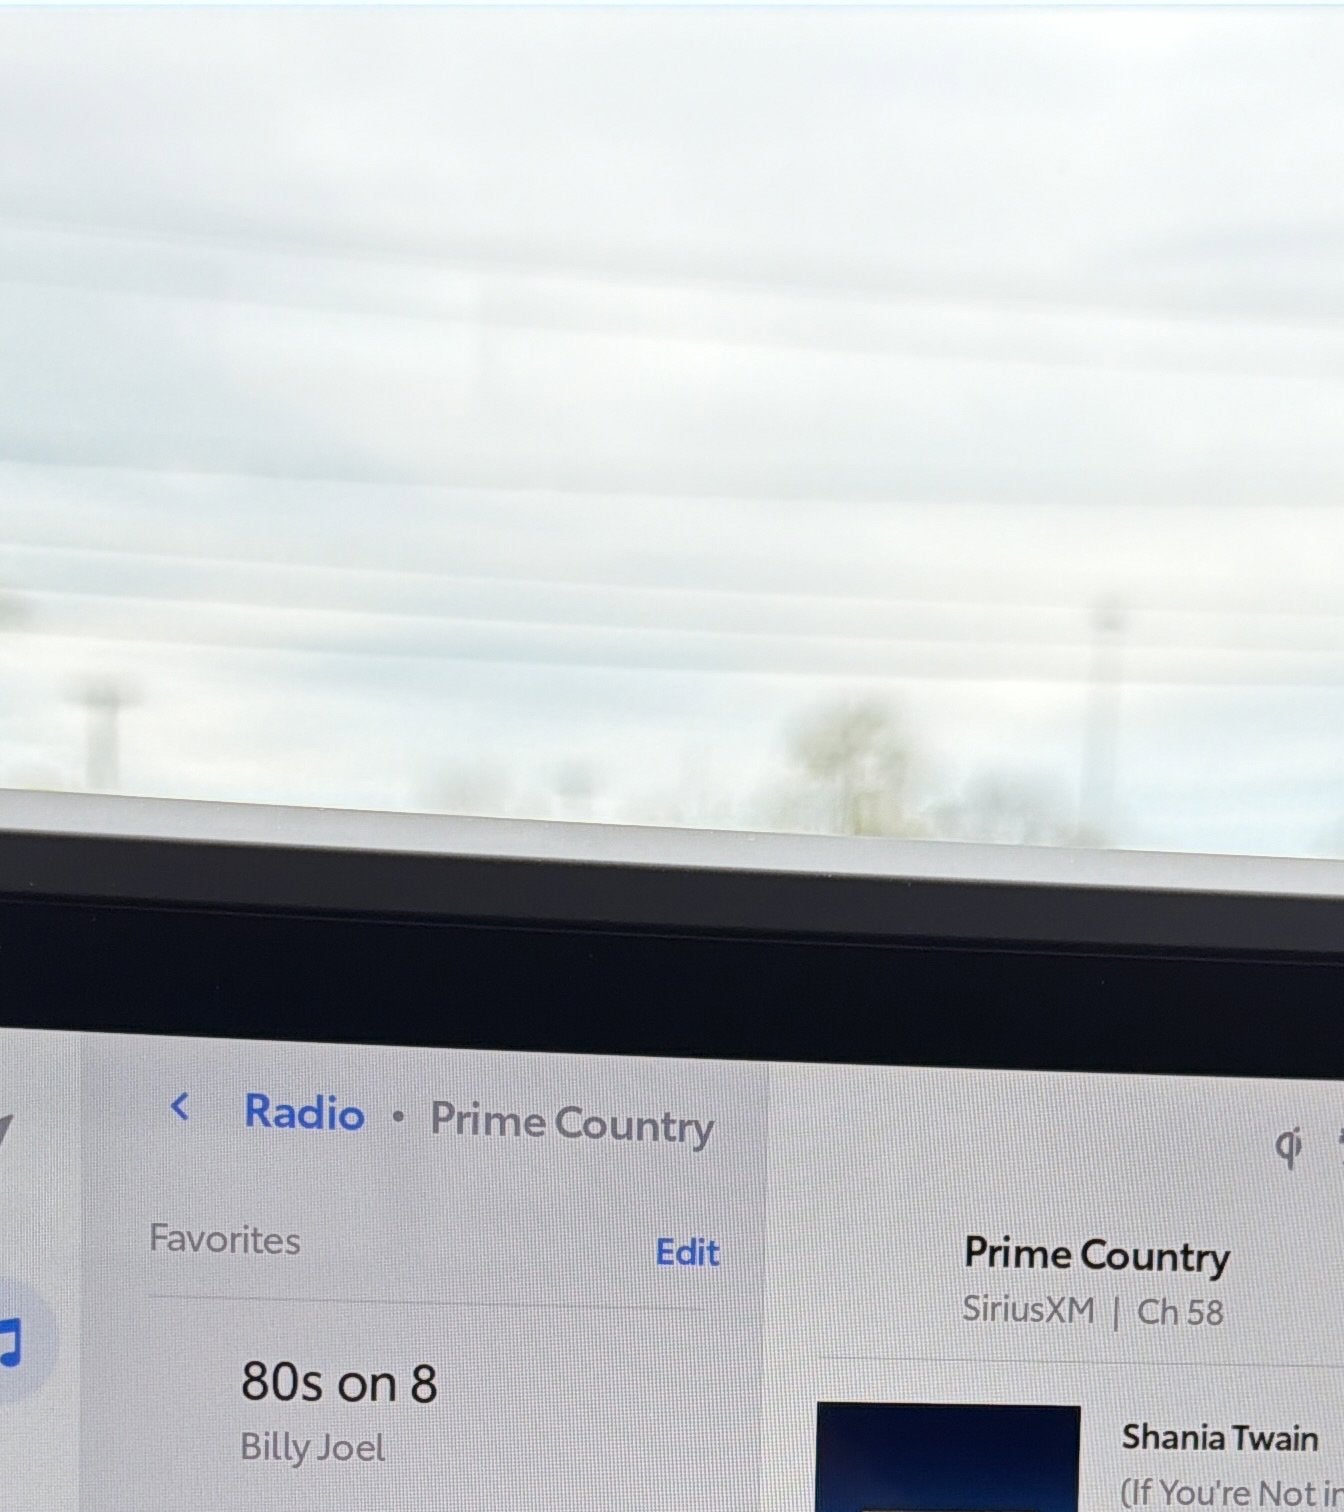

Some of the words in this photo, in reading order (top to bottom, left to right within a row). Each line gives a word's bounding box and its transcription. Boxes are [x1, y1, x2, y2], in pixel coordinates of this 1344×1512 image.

[245, 1092, 366, 1131] Radio
[431, 1099, 547, 1139] Prime
[555, 1106, 716, 1153] Country
[149, 1222, 301, 1256] Favorites
[657, 1236, 721, 1267] Edit
[965, 1235, 1072, 1271] Prime
[1080, 1238, 1231, 1281] Country
[962, 1293, 1095, 1326] SiriusXM
[1137, 1298, 1180, 1326] Ch
[1186, 1299, 1224, 1326] 58
[242, 1360, 323, 1402] 80s
[338, 1371, 396, 1402] on
[412, 1364, 437, 1402] 8
[240, 1431, 311, 1468] Billy
[316, 1433, 385, 1462] Joel
[1122, 1423, 1225, 1451] Shania
[1231, 1425, 1319, 1452] Twain
[1120, 1477, 1154, 1509] (If
[1159, 1480, 1251, 1507] You're
[1259, 1481, 1316, 1507] Not
